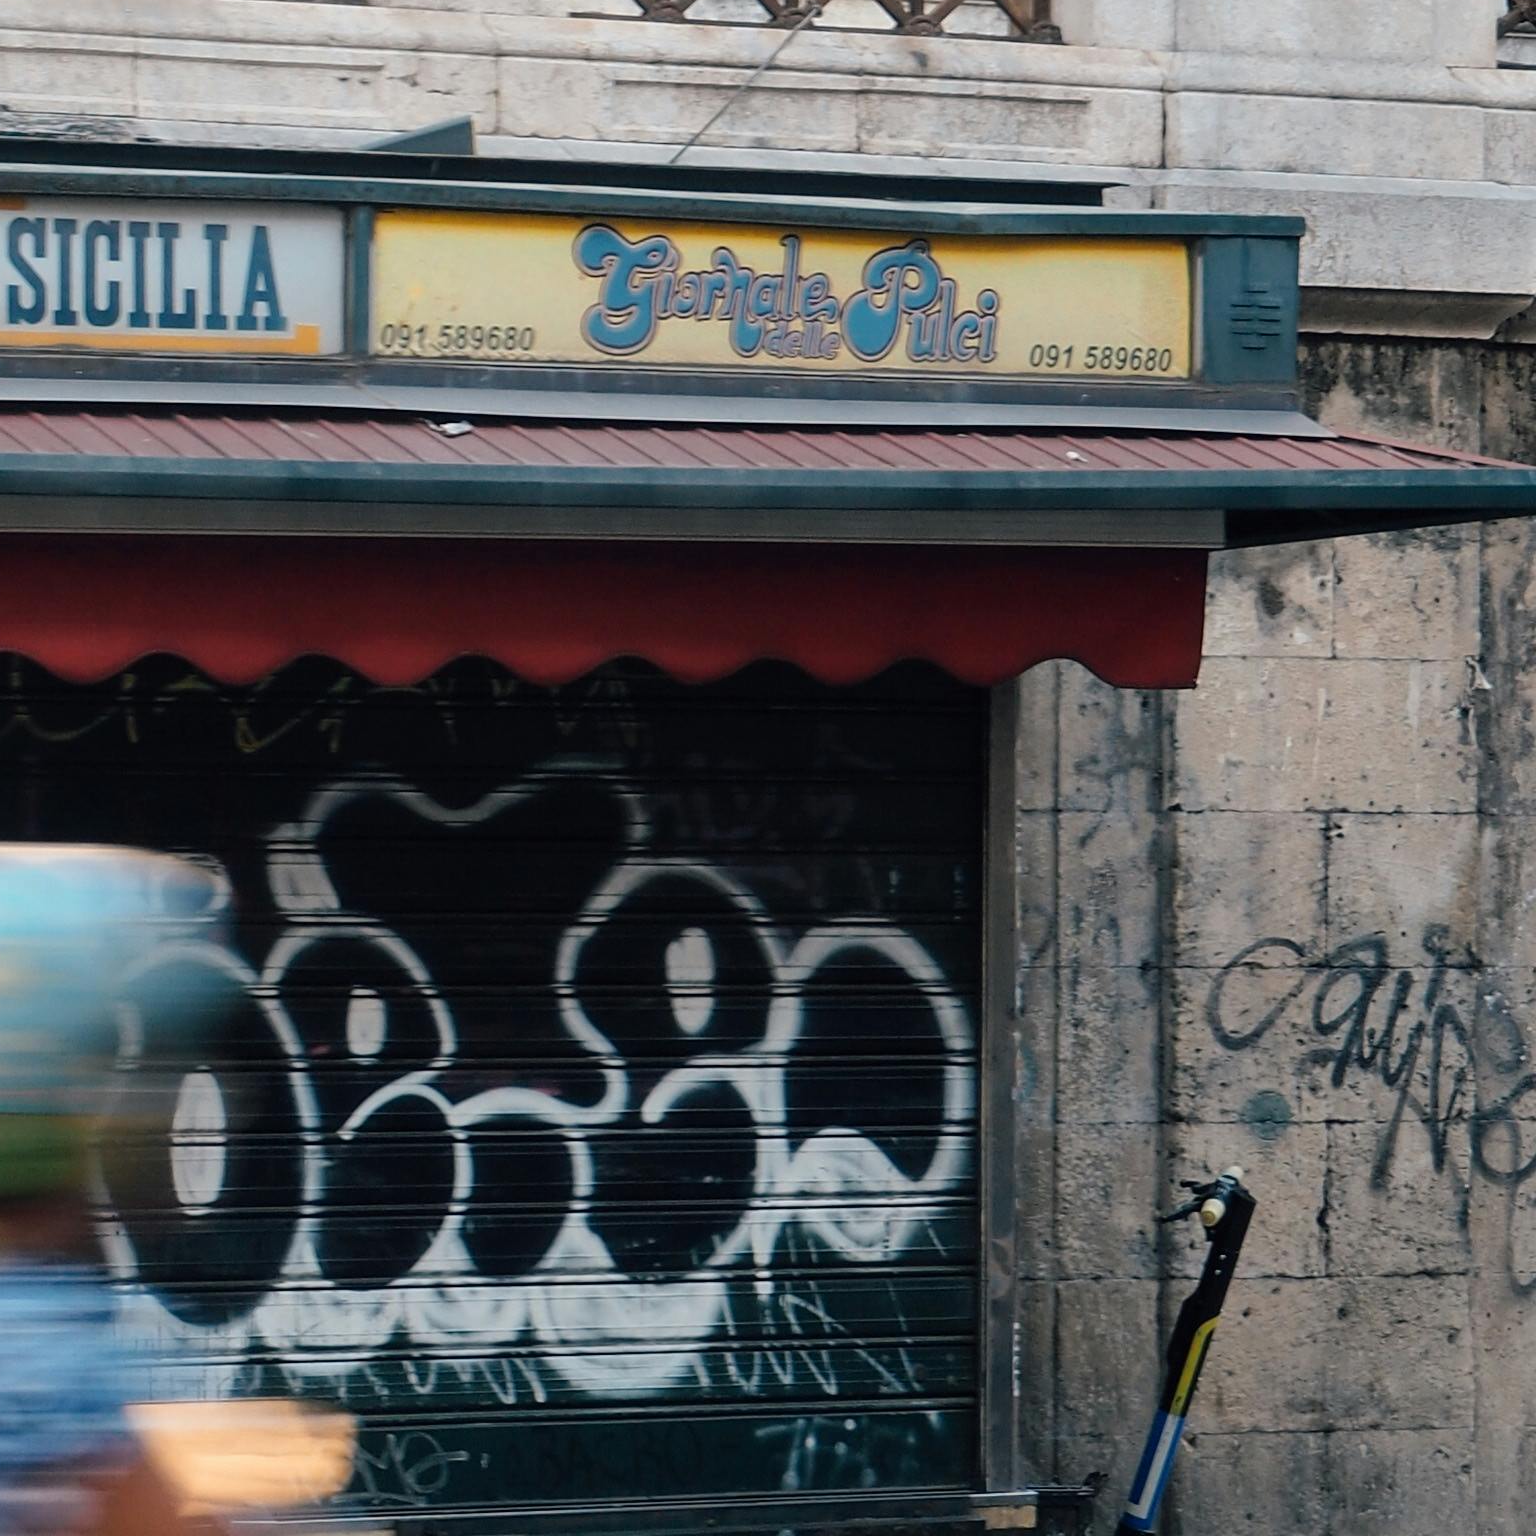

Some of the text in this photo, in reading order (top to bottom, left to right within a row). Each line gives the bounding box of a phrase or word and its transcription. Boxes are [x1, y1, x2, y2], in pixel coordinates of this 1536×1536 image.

[7, 217, 289, 332] SICILIA
[572, 223, 999, 363] Giornale delle Pulci
[380, 323, 536, 351] 091 589680
[1029, 344, 1173, 372] 091 589680
